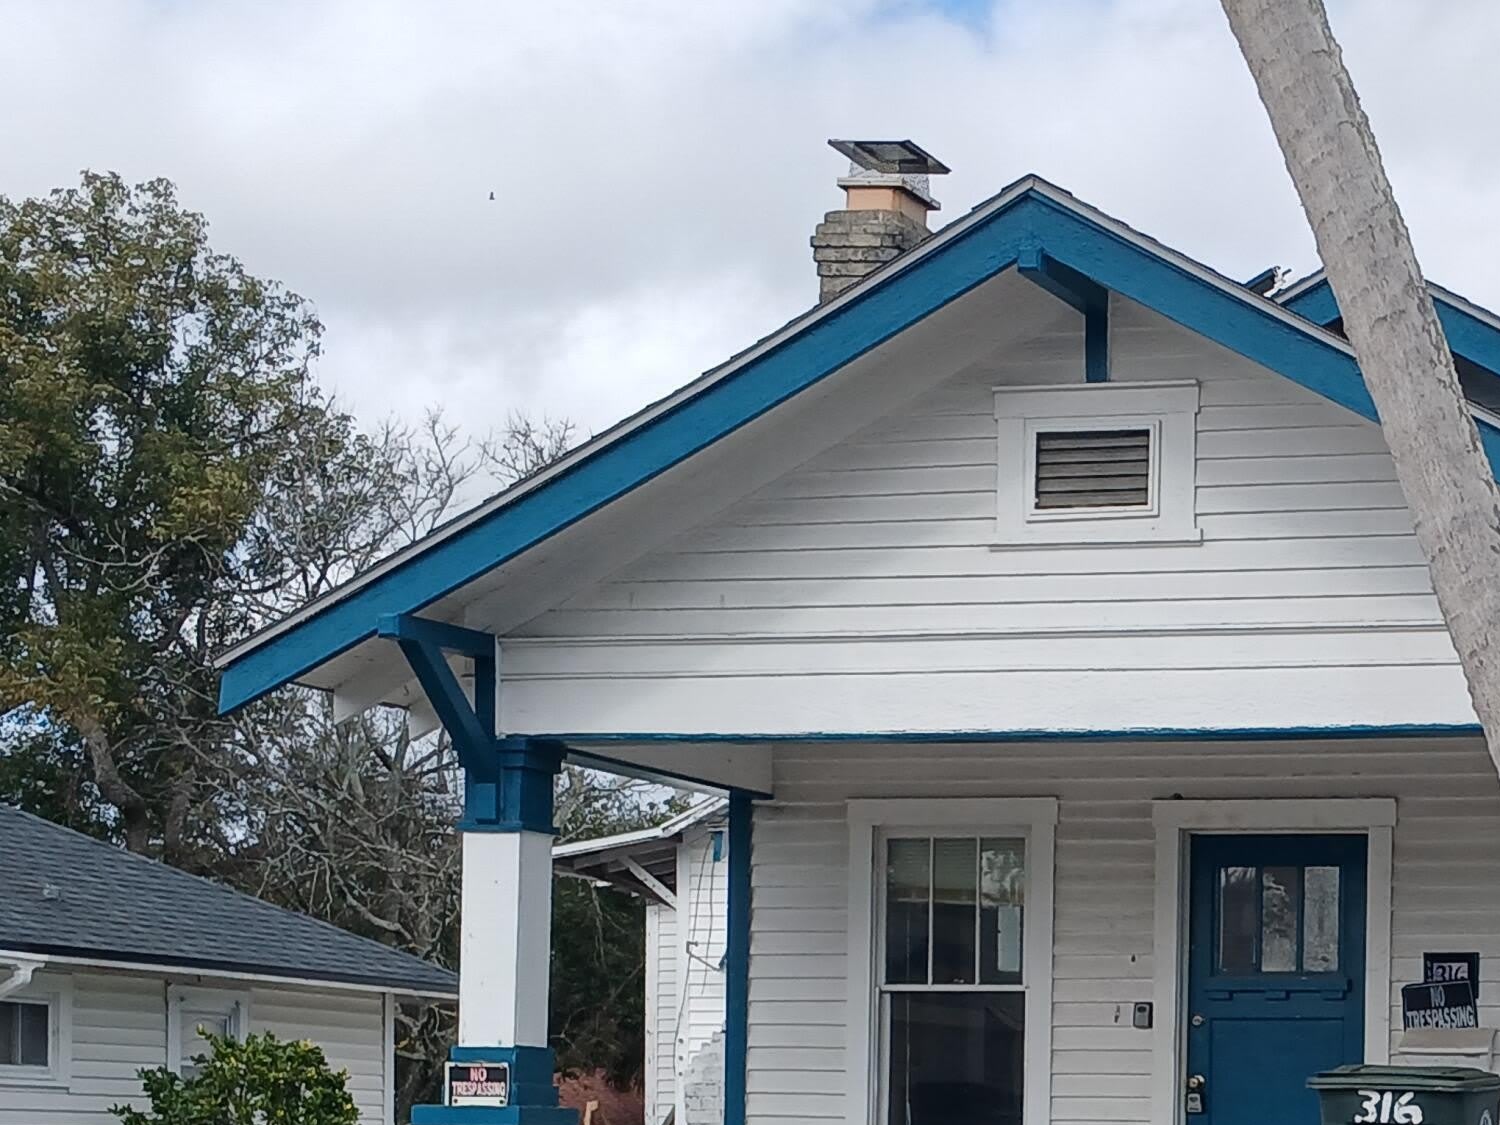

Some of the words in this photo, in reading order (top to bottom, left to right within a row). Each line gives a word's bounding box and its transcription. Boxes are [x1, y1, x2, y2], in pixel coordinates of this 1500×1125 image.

[1430, 985, 1446, 1008] NO
[1406, 1004, 1474, 1029] TRESPASSING
[470, 1067, 487, 1082] NO
[451, 1081, 506, 1096] TRESPASSING
[1354, 1090, 1423, 1125] 316
